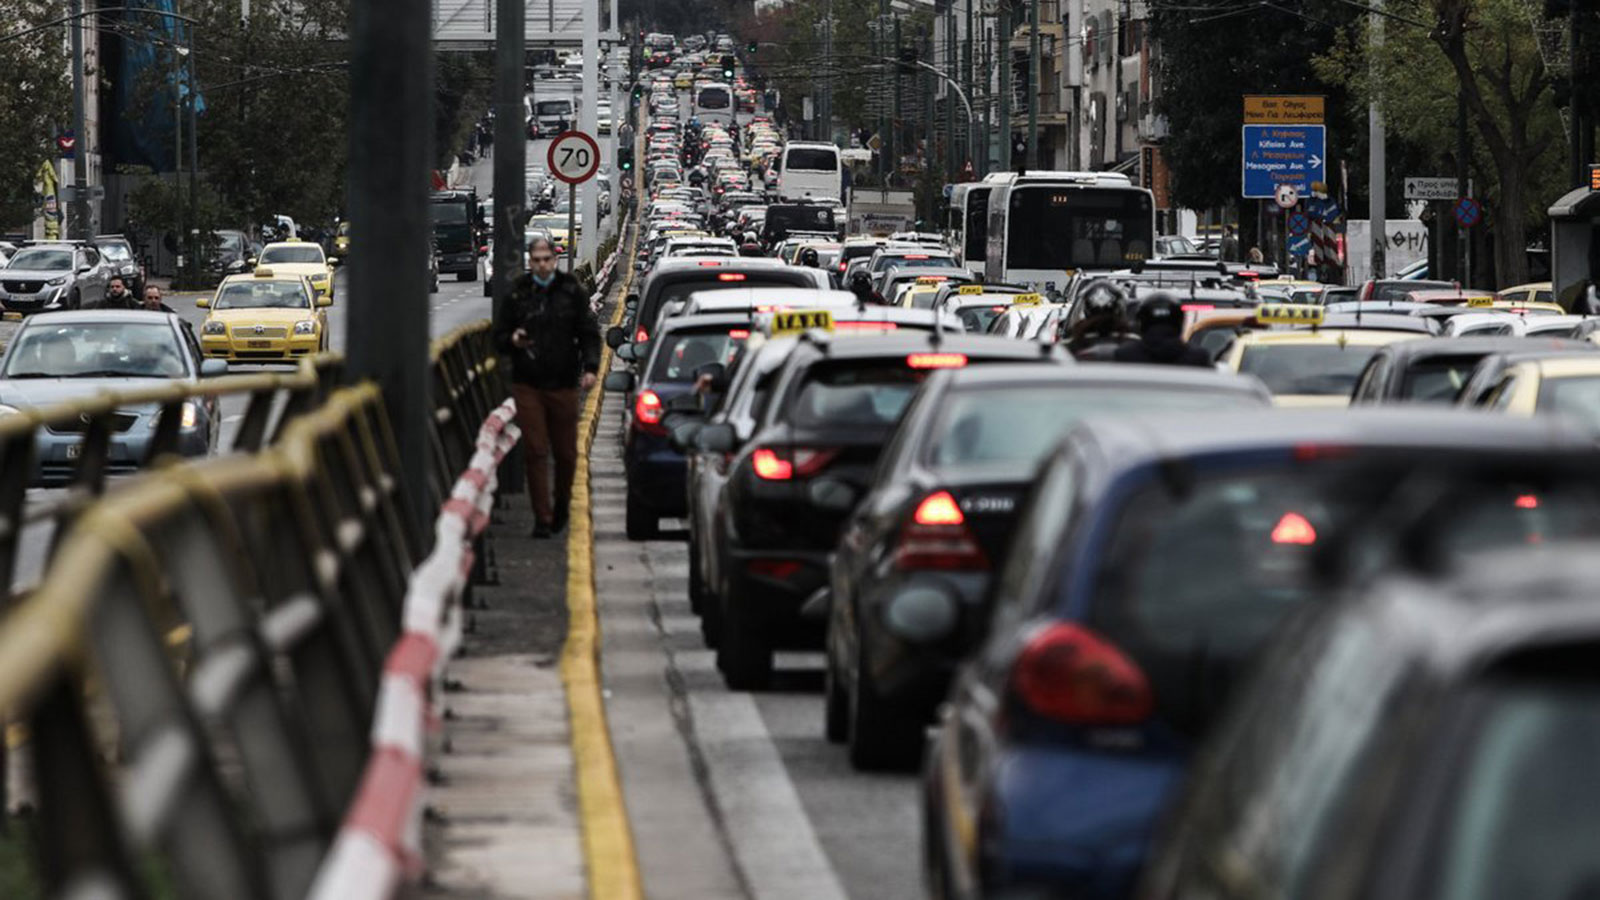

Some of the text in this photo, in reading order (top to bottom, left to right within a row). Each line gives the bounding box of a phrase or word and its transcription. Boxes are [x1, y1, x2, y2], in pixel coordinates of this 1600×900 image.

[560, 148, 589, 167] 70
[1418, 180, 1439, 189] Προς
[777, 312, 829, 329] TAXI
